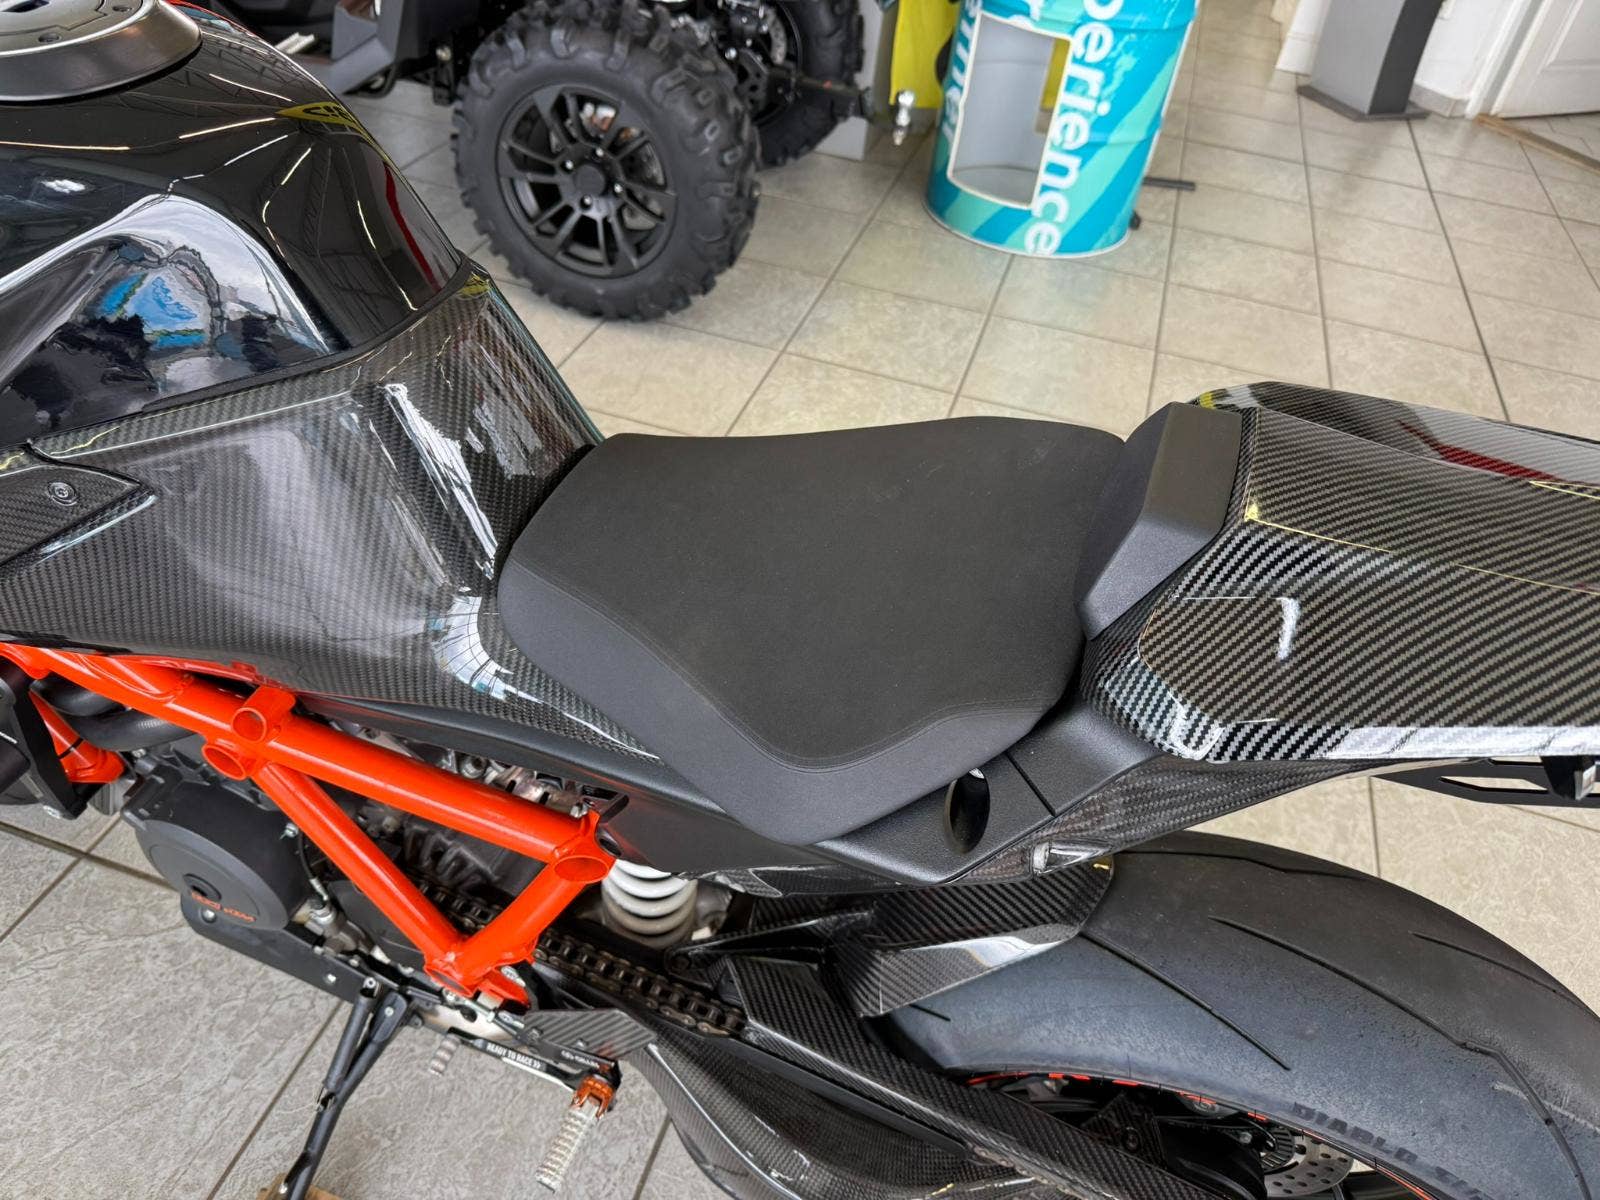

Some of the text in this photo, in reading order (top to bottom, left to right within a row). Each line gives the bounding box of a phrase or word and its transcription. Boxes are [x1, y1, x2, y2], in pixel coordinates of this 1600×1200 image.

[486, 1042, 534, 1067] READY TO RACE
[1293, 1101, 1419, 1166] DIABLO
